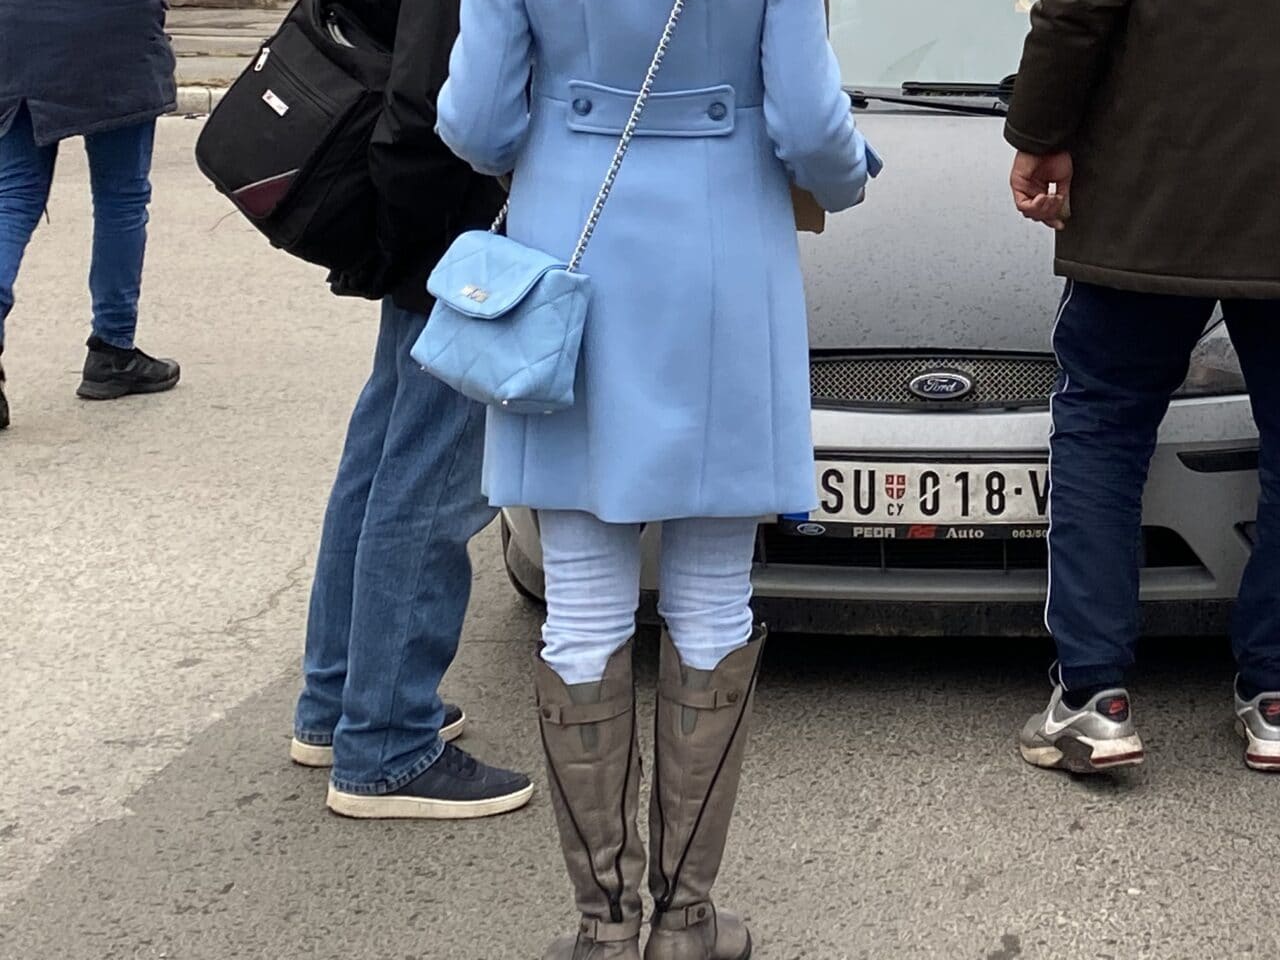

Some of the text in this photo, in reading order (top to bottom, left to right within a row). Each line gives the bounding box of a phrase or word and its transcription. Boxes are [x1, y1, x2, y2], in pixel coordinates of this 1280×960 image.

[923, 378, 958, 392] Ford
[821, 468, 876, 515] SU
[853, 526, 896, 539] PEDA
[945, 526, 985, 539] Auto
